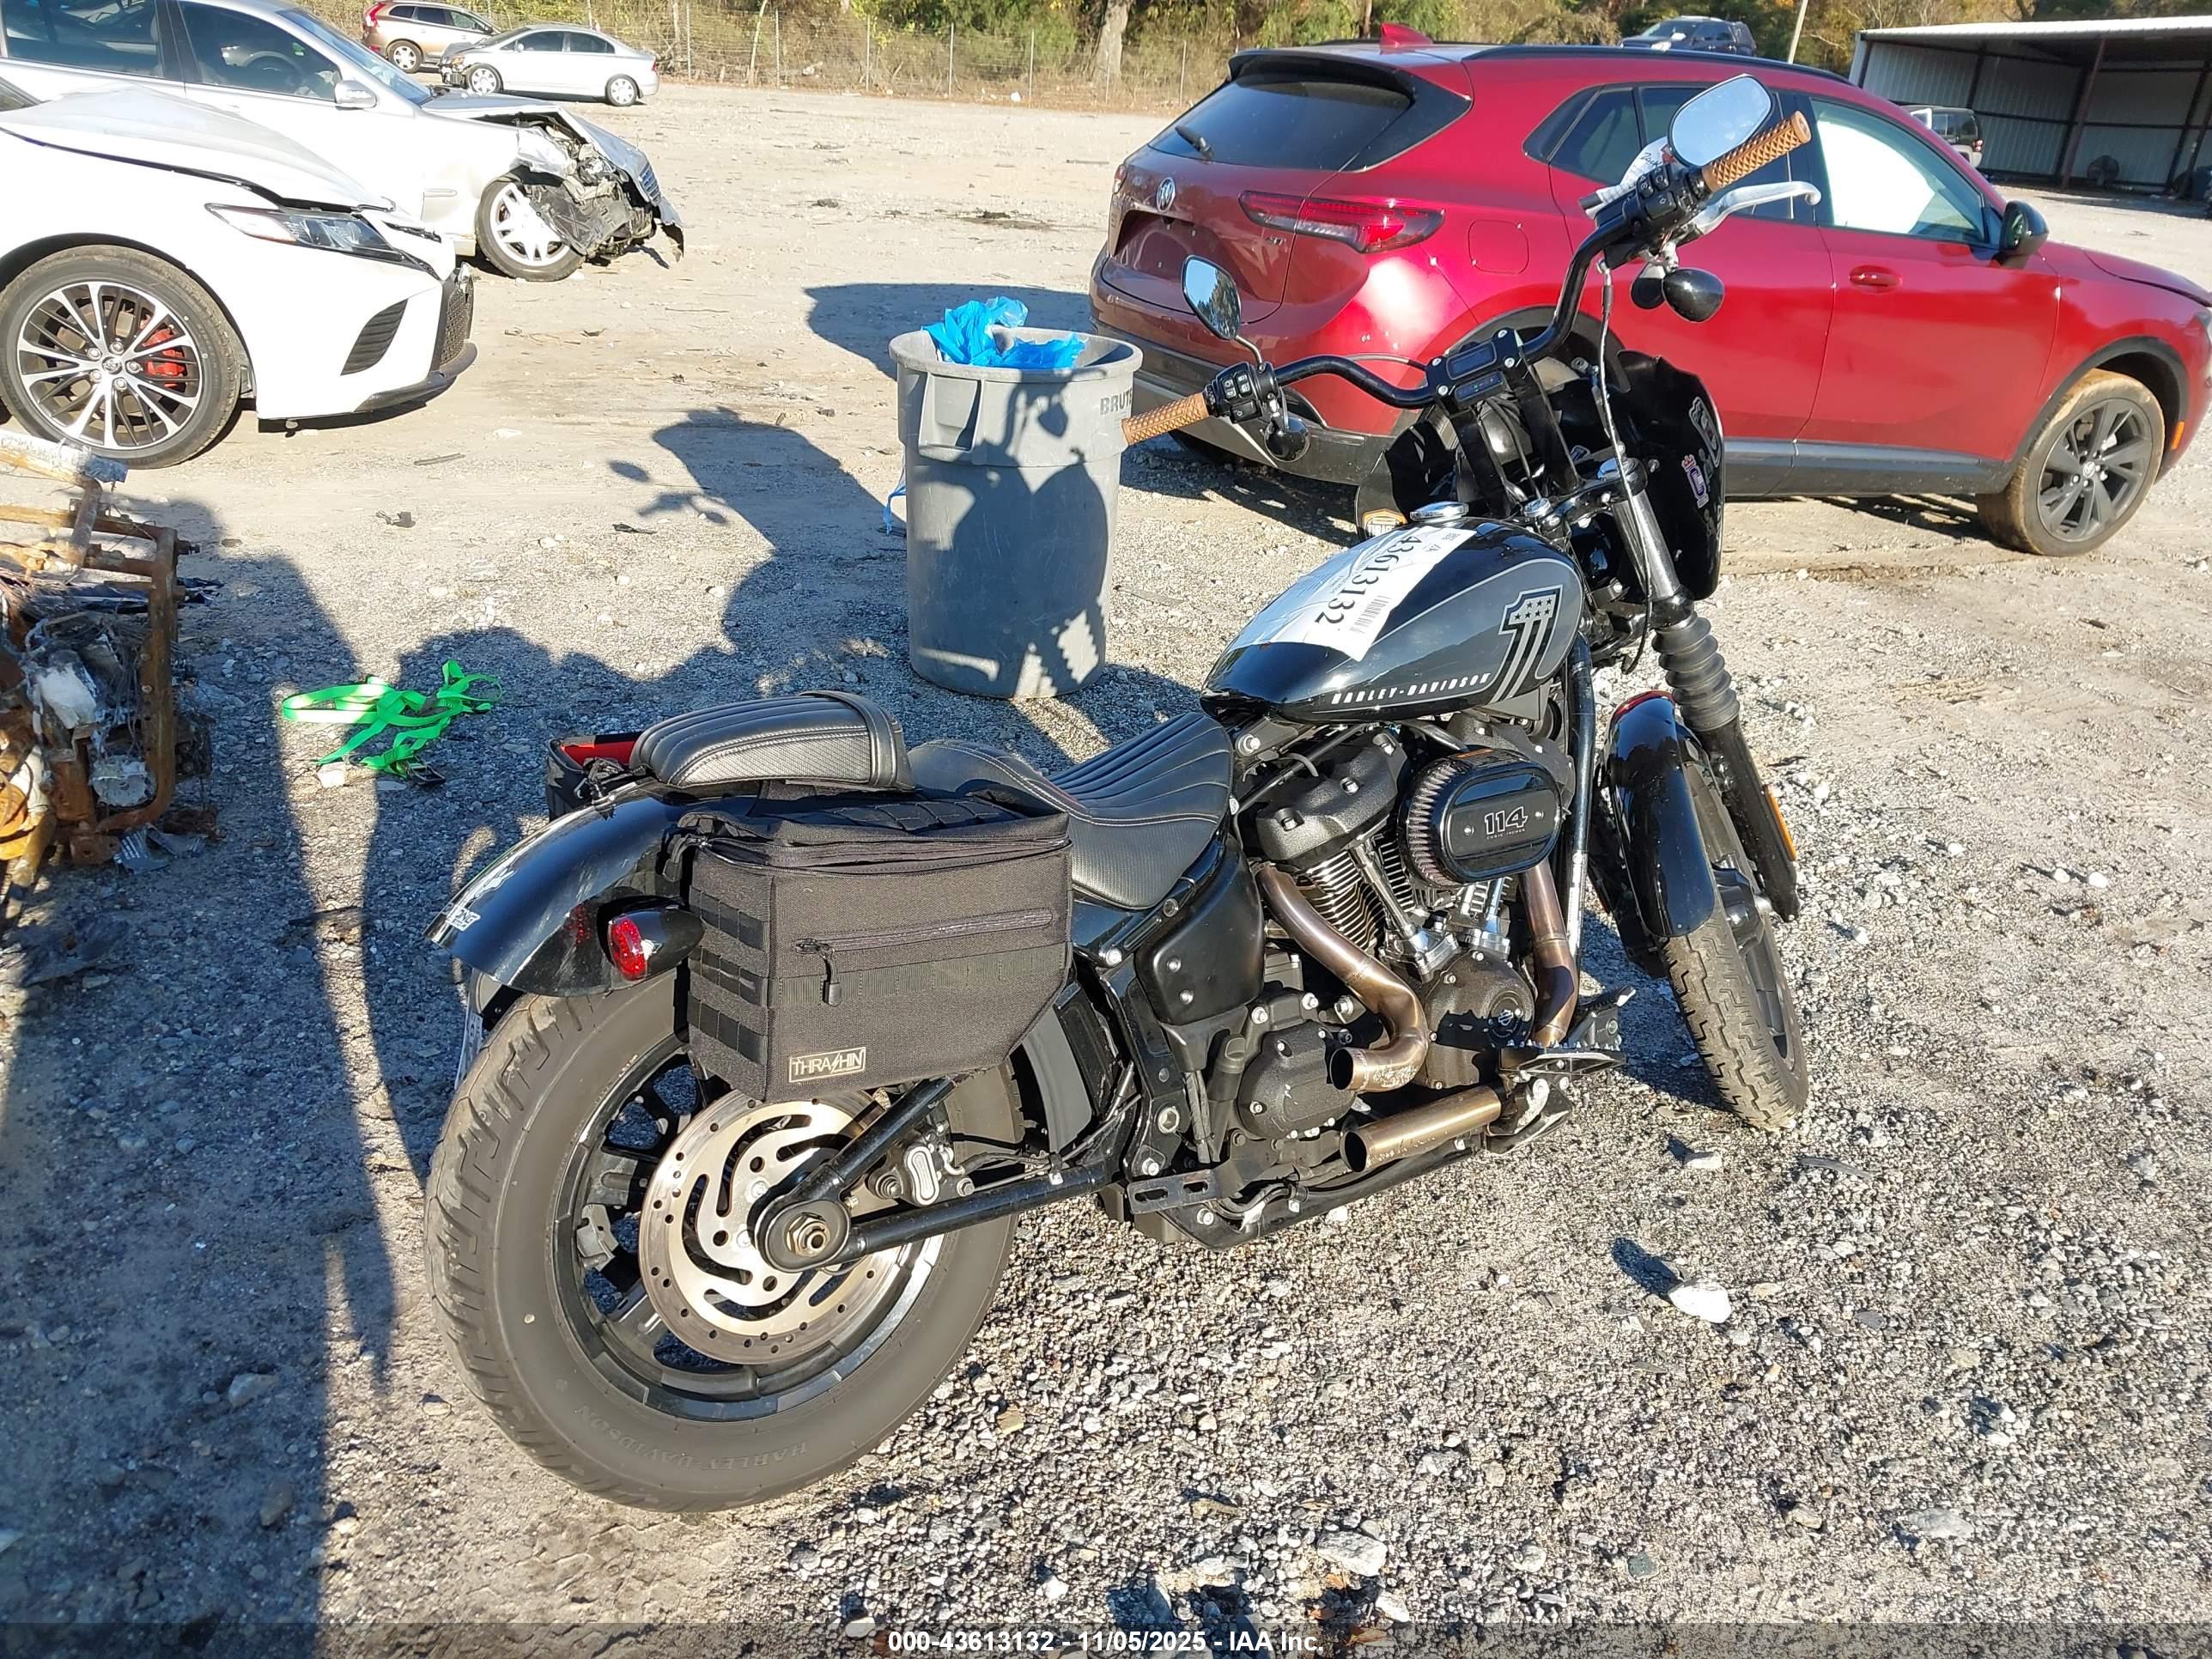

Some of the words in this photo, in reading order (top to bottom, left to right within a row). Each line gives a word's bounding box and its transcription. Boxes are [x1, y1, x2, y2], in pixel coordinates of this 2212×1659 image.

[1315, 536, 1422, 624] 43613132
[1331, 673, 1491, 705] HARLEY-DAVIDSON
[1484, 805, 1528, 835] 114
[575, 1404, 808, 1469] HARLEY-DAVIDSON
